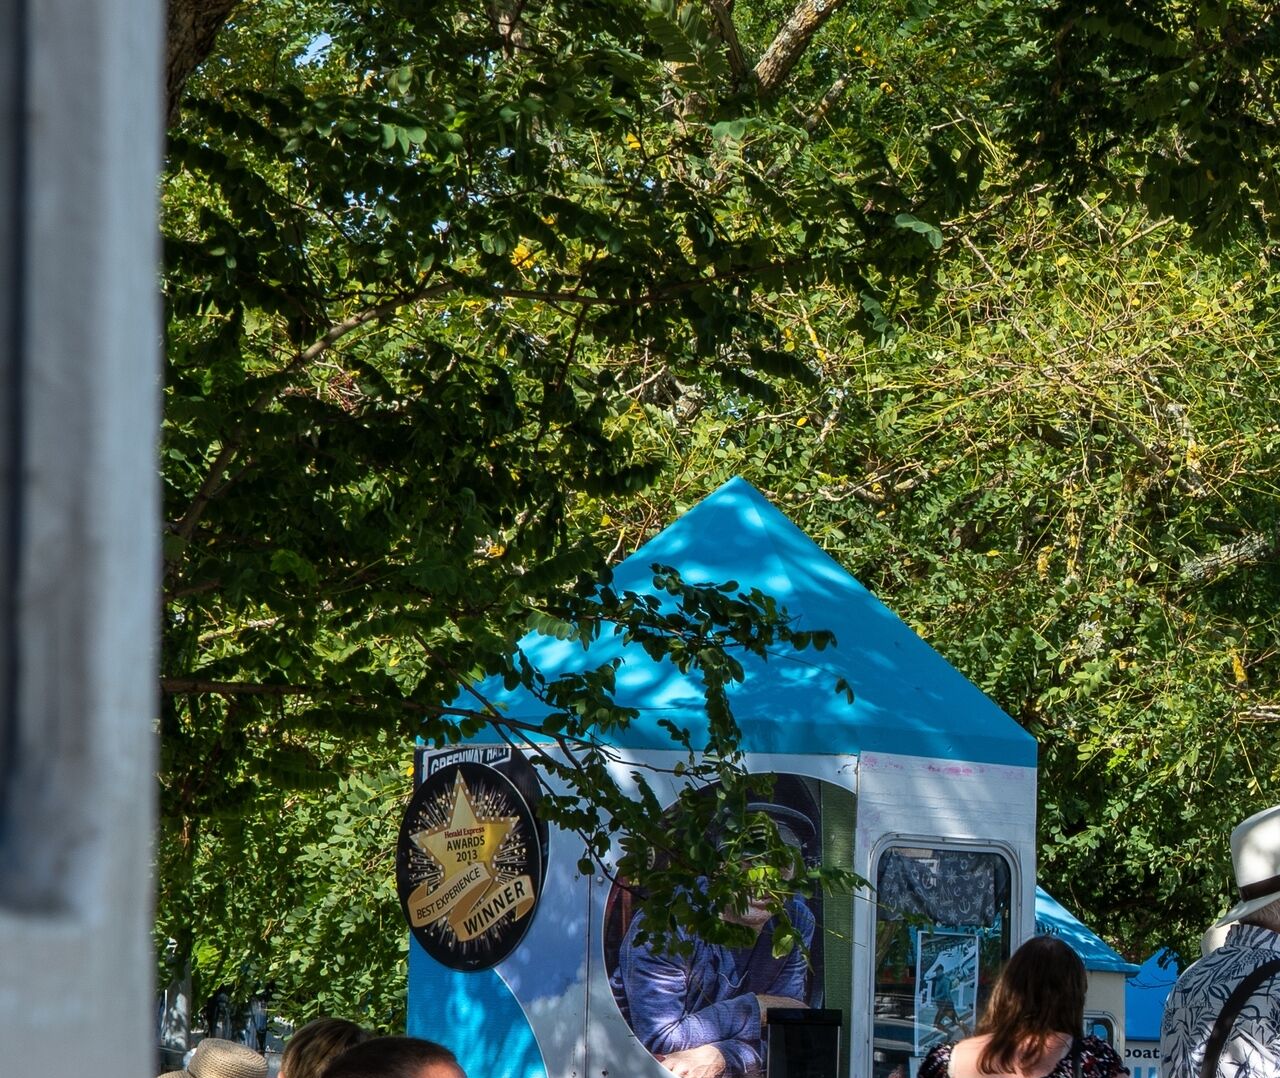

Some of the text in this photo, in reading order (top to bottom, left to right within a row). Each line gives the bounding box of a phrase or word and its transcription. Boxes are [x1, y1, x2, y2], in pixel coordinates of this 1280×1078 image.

[444, 826, 485, 839] Herald Express
[446, 835, 486, 852] AWARDS
[456, 849, 478, 863] 2013
[416, 867, 481, 919] BEST EXPERIENCE
[463, 880, 526, 937] WINNER
